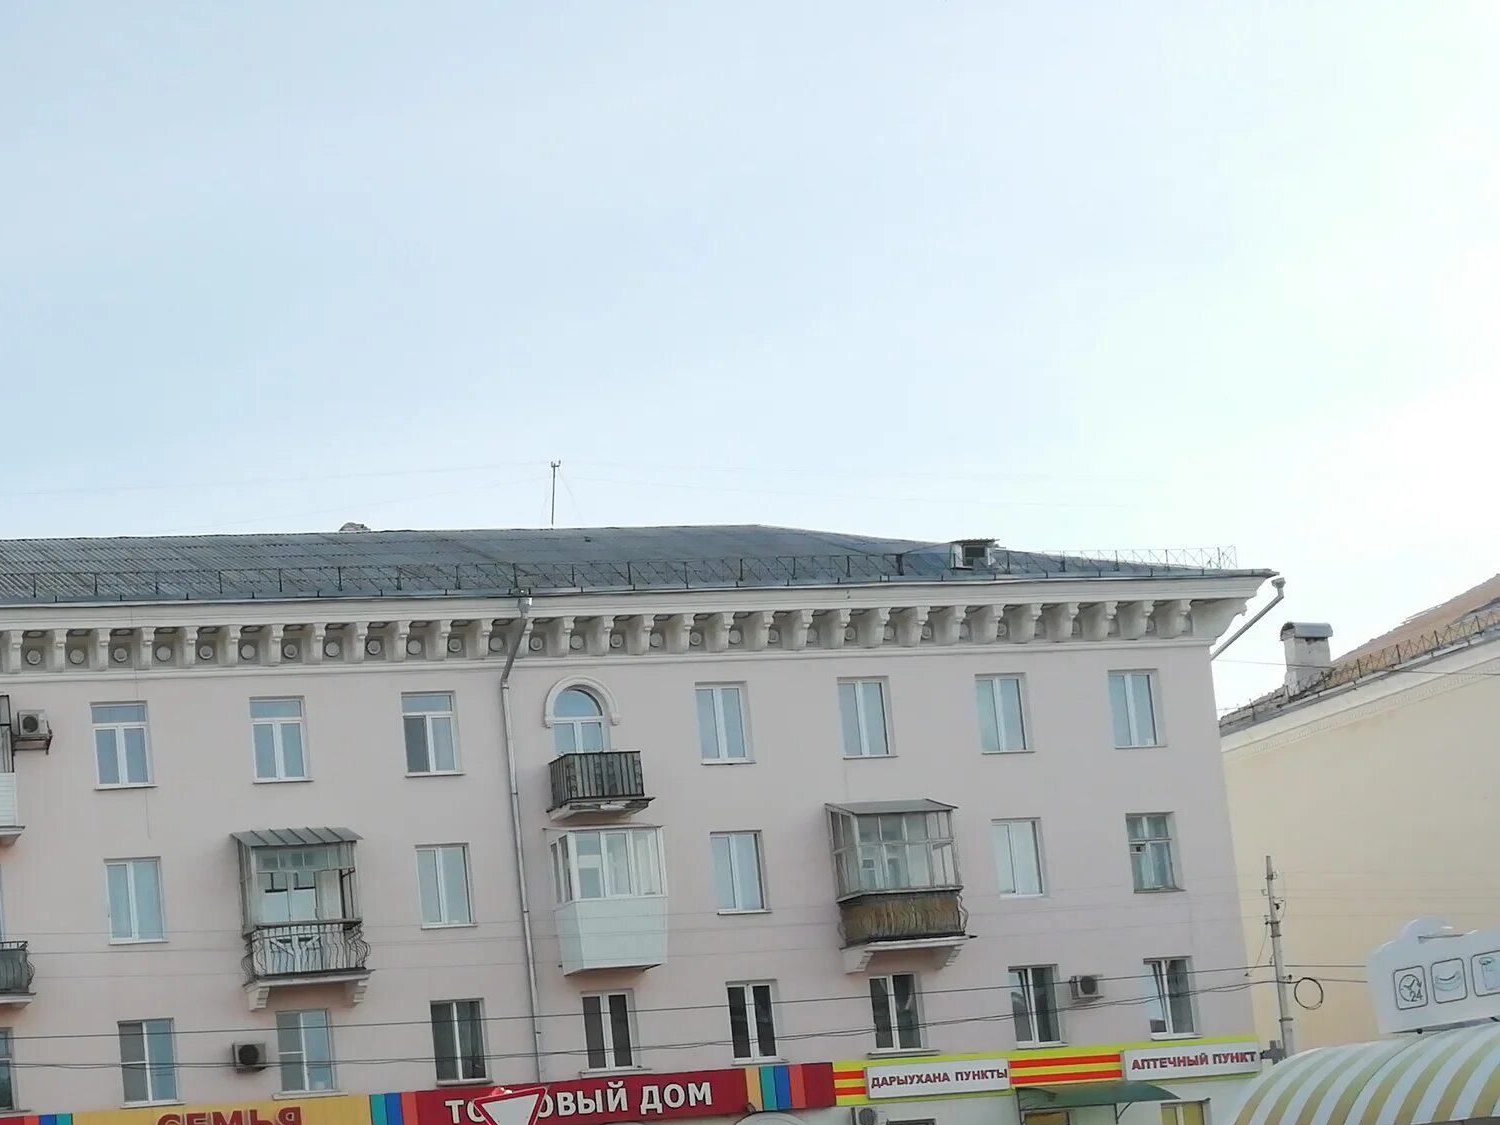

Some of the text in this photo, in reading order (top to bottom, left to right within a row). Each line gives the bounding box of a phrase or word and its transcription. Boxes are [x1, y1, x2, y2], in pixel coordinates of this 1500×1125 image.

[1132, 1051, 1257, 1070] АПТЕЧНЫЙ ПУНКТ
[871, 1068, 1007, 1088] ДАРЫУХАНА ПУНКТЫ
[445, 1080, 712, 1124] ТООВЫЙ ДОМ
